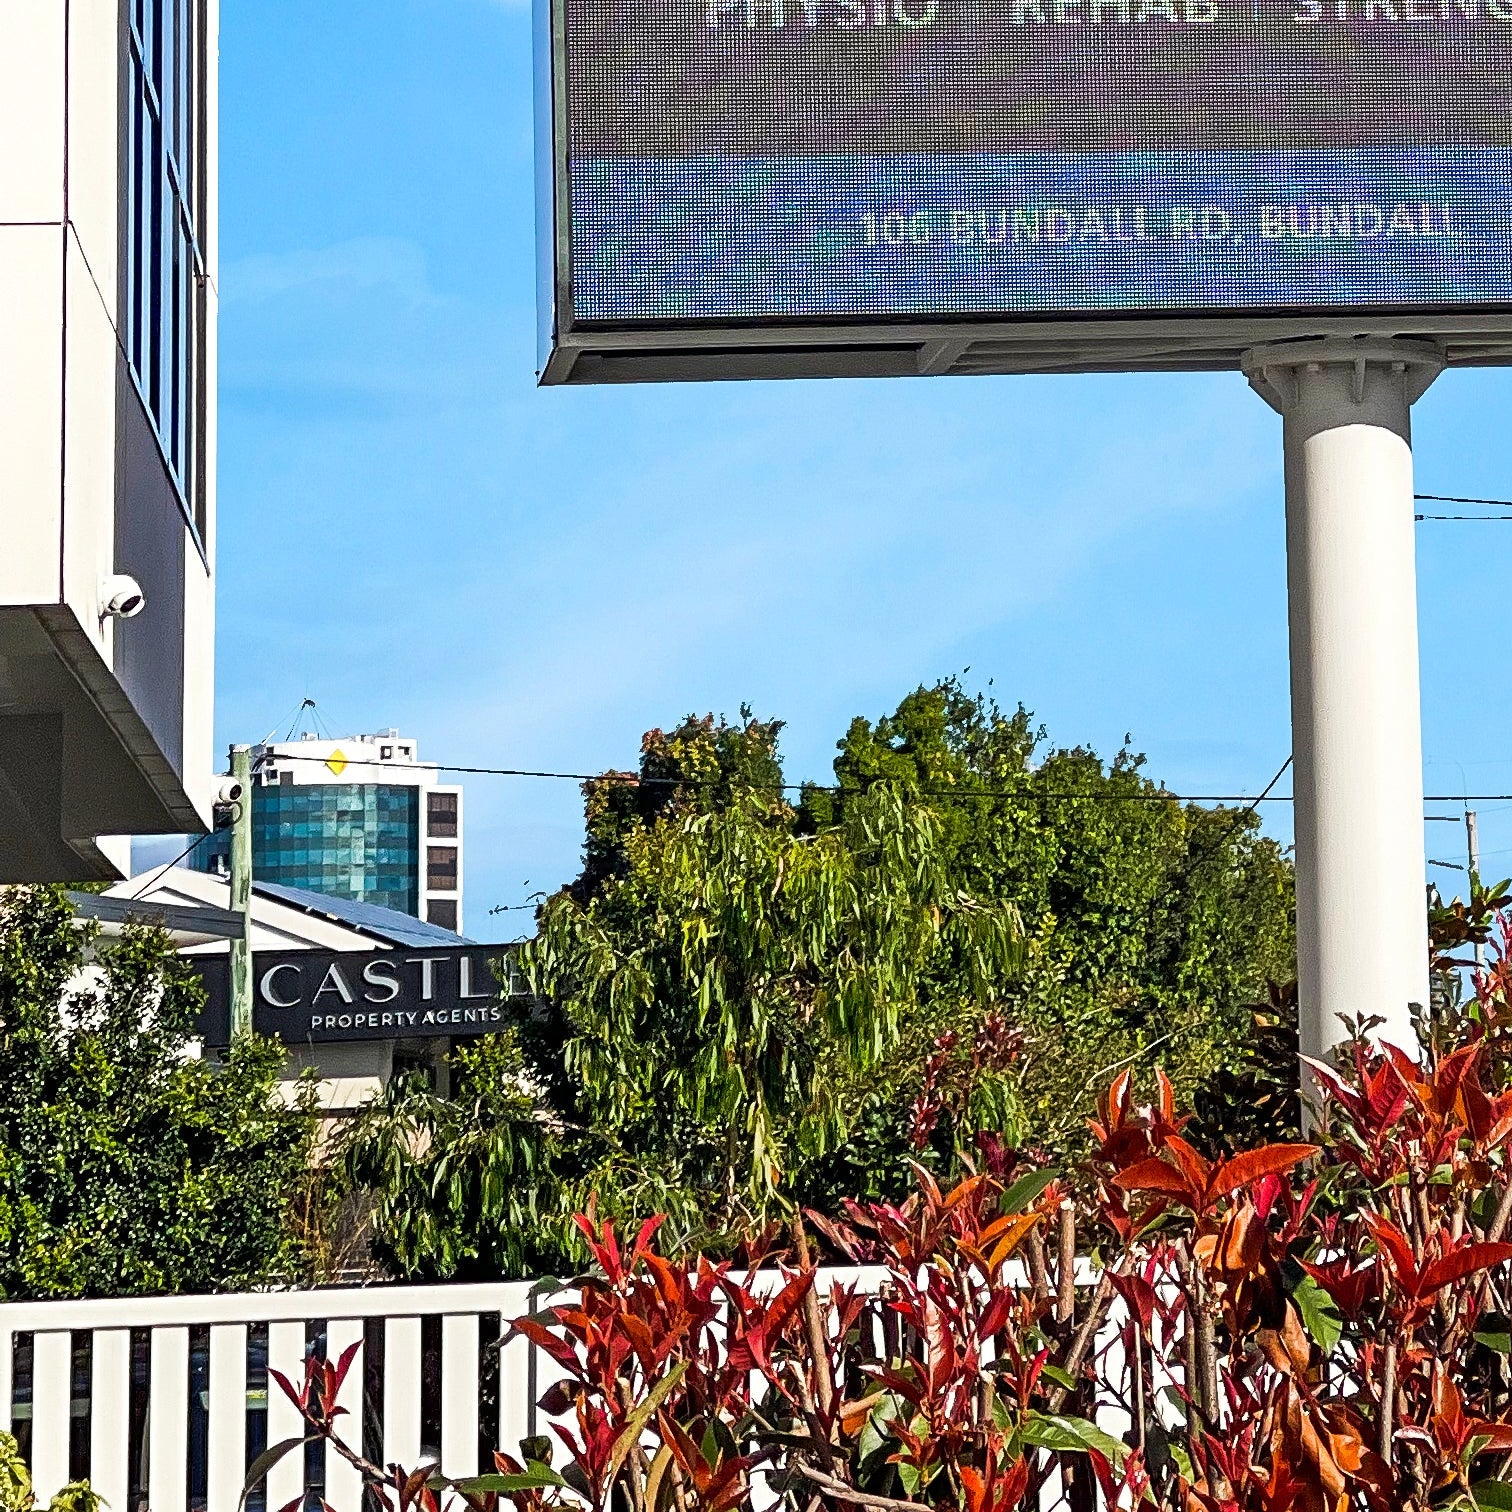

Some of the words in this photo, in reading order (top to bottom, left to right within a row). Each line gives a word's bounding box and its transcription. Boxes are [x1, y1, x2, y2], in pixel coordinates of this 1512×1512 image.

[862, 210, 932, 245] 106
[948, 207, 1158, 245] BUNDALL
[1259, 203, 1457, 242] BUNDALL
[311, 1011, 417, 1029] PROPERTY
[421, 1006, 501, 1025] AGENTS
